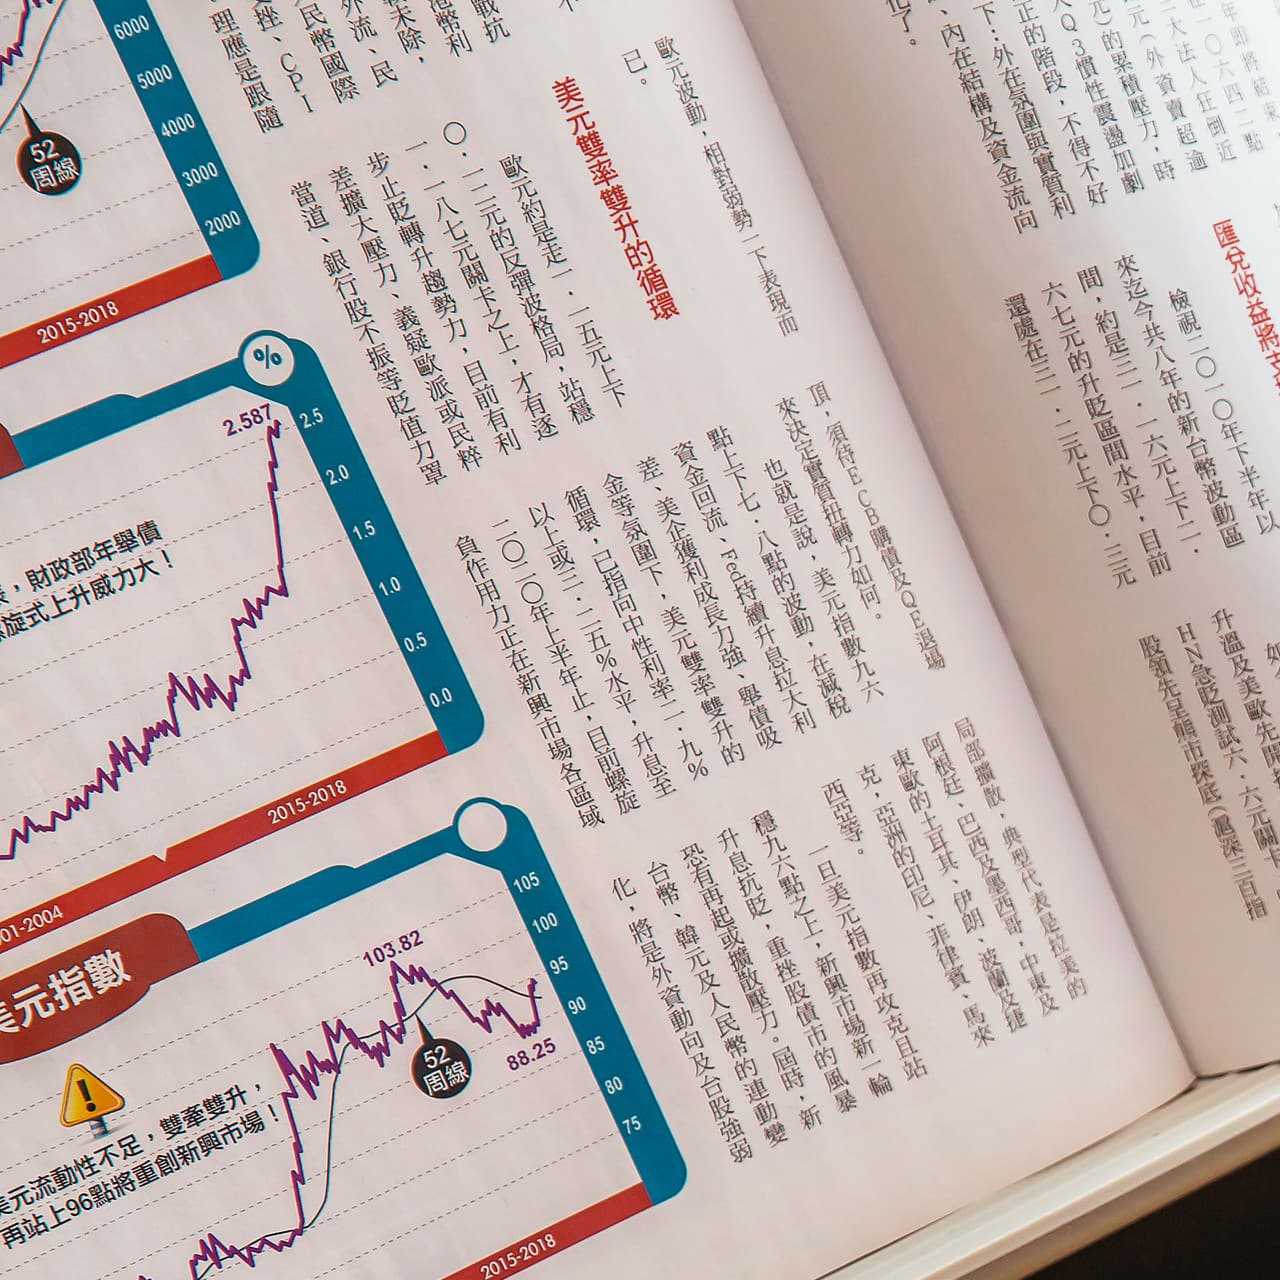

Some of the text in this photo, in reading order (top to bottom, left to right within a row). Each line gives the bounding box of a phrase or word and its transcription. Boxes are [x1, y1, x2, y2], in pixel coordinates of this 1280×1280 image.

[113, 15, 150, 41] 6000
[136, 64, 173, 91] 5000
[159, 113, 196, 139] 4000
[30, 139, 57, 160] 52
[29, 160, 81, 188] 周線
[181, 162, 219, 188] 3000
[551, 75, 681, 322] 美元雙率雙升的循環
[204, 210, 241, 236] 2000
[35, 300, 119, 344] 2015-2018
[253, 346, 282, 369] %
[1114, 253, 1245, 549] 來迄今共八年的新台幣波動區
[222, 404, 273, 436] 2.587
[299, 407, 325, 428] 2.5
[326, 464, 349, 485] 2.0
[353, 520, 376, 540] 1.5
[0, 520, 163, 604] ，財政部年舉債
[0, 550, 174, 642] 旋式上升威力大！
[378, 576, 401, 596] 1.0
[403, 632, 427, 652] 0.5
[455, 534, 605, 829] 負作用力正在新興市場各區域
[429, 687, 453, 707] 0.0
[267, 780, 348, 825] 2015-2018
[513, 872, 540, 894] 105
[0, 905, 64, 946] 01-2004
[531, 912, 558, 933] 100
[362, 929, 424, 968] 103.82
[549, 956, 570, 974] 95
[807, 843, 928, 1081] 一旦美元指數再攻克且站
[567, 996, 587, 1015] 90
[425, 1046, 451, 1068] 52
[506, 1037, 557, 1072] 88.25
[586, 1036, 606, 1055] 85
[423, 1062, 470, 1097] 周線
[605, 1076, 623, 1094] 80
[622, 1115, 642, 1134] 75
